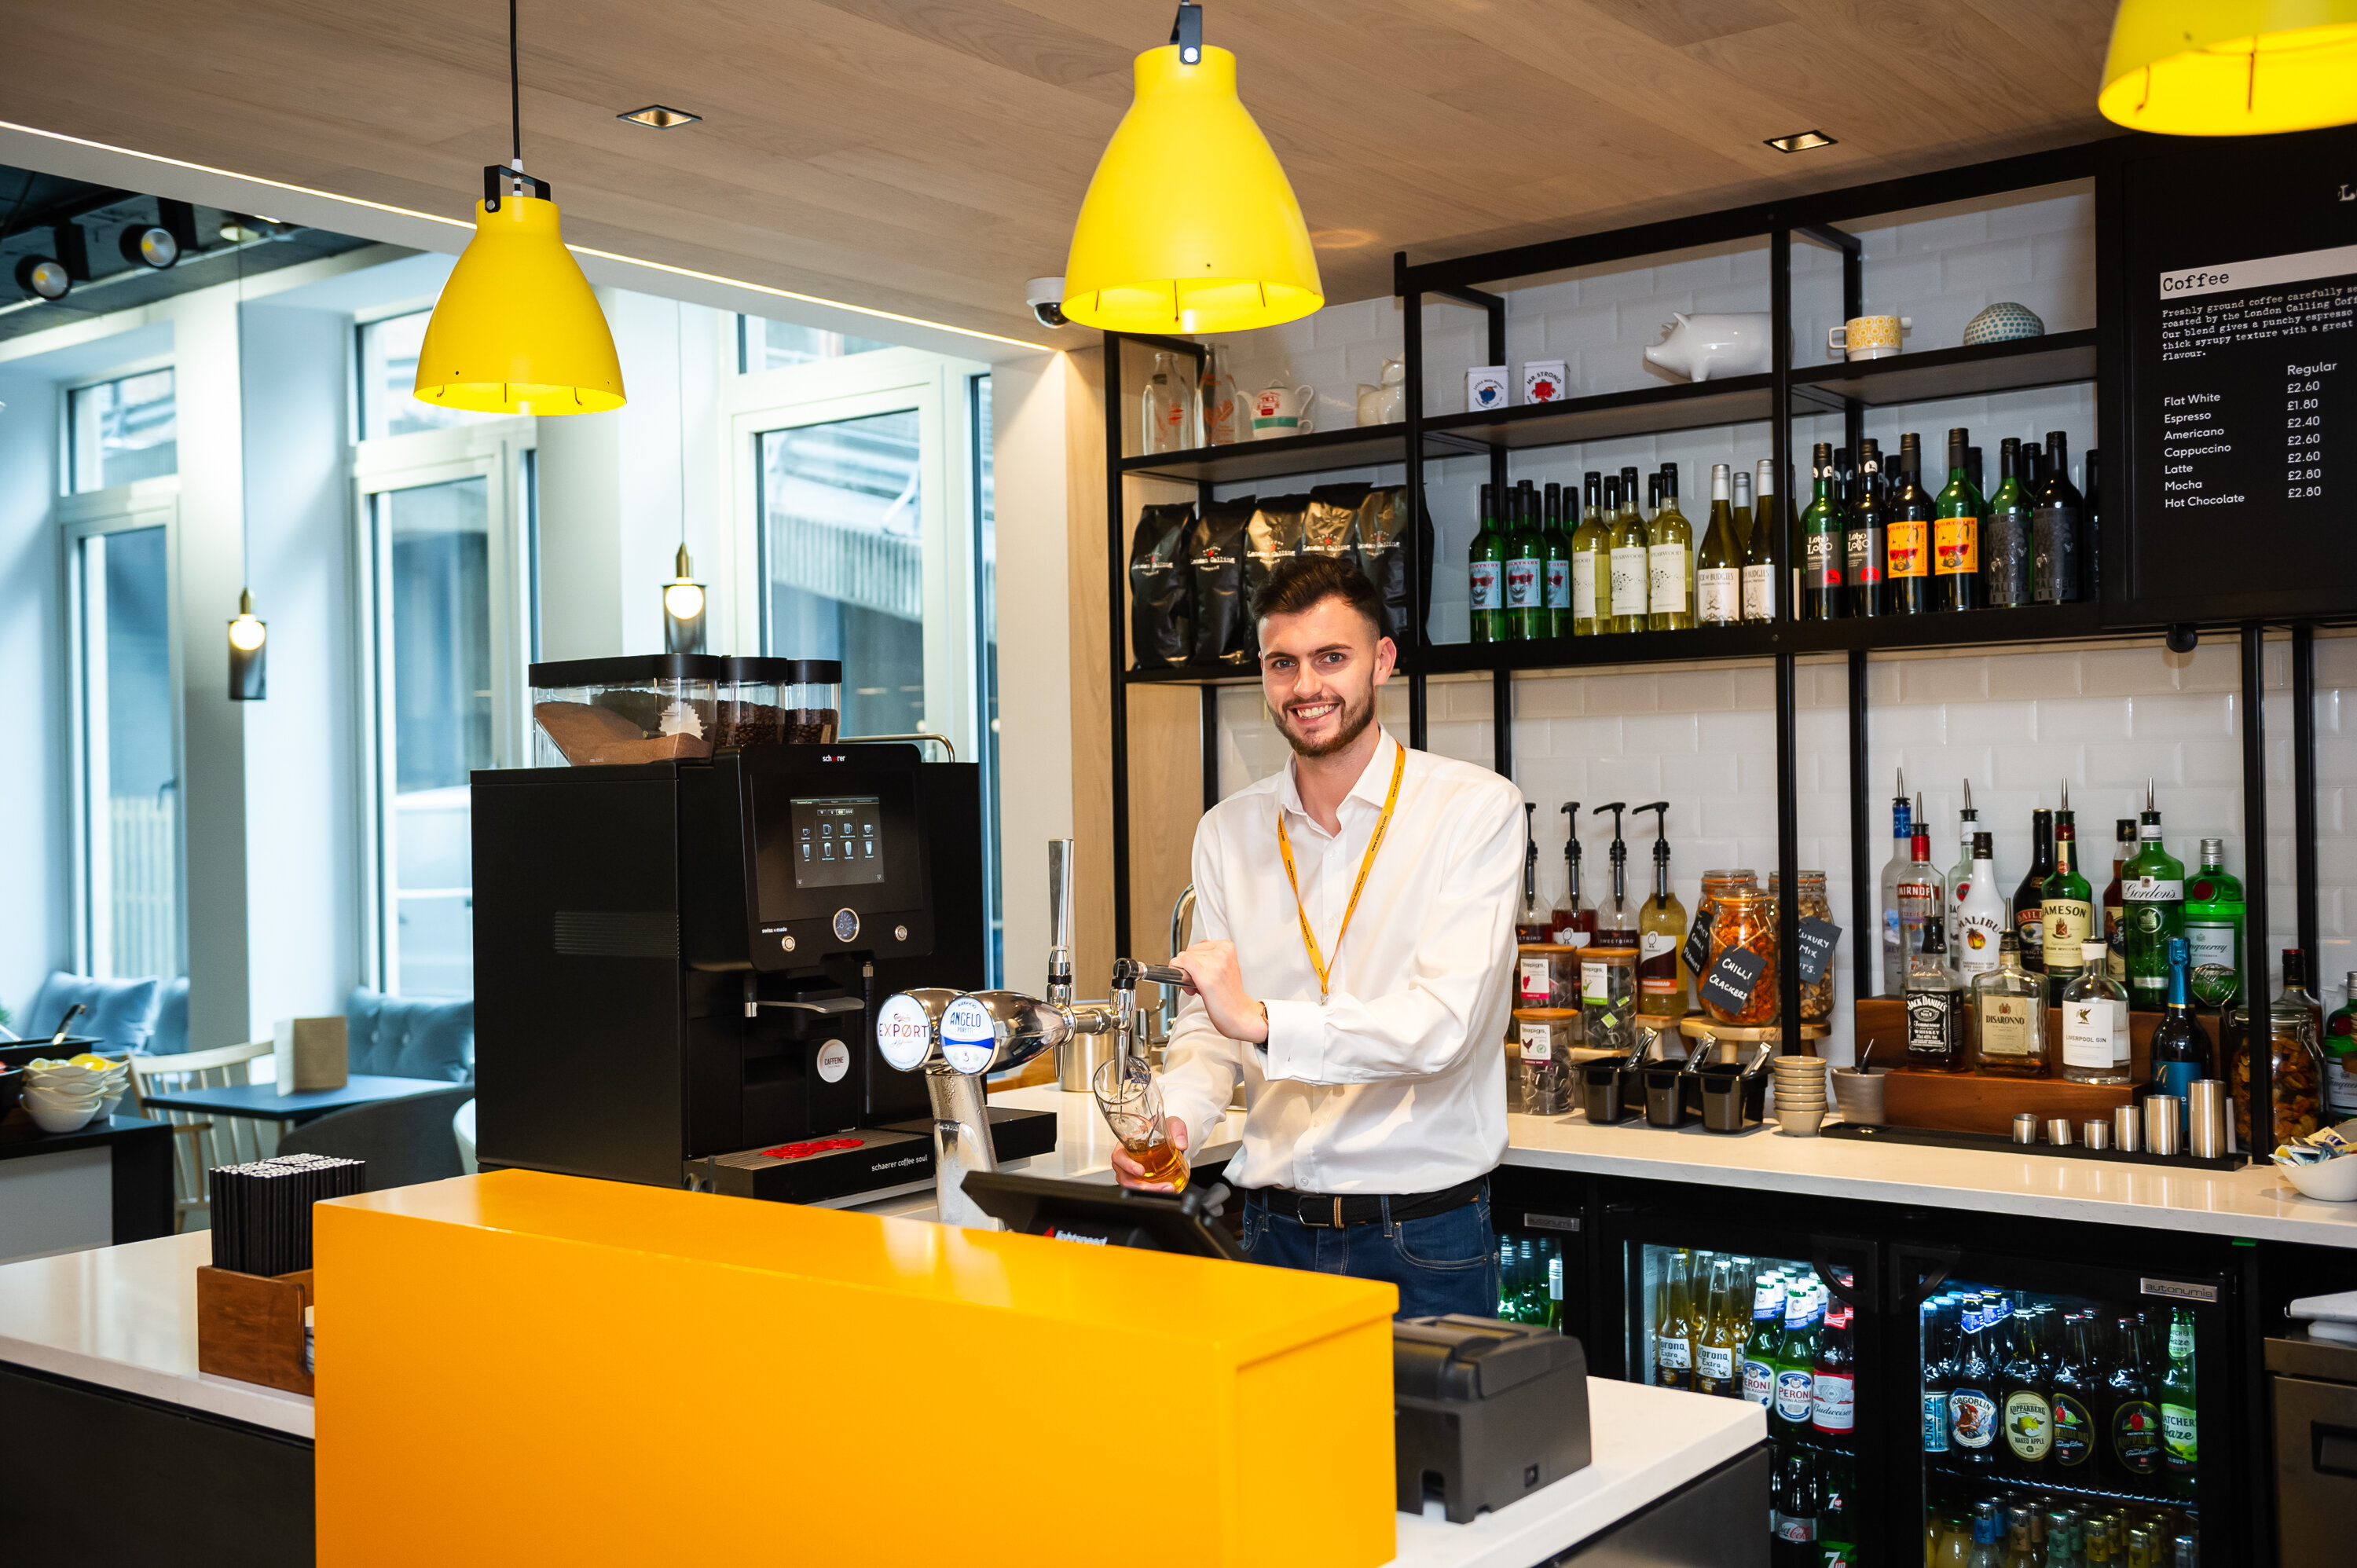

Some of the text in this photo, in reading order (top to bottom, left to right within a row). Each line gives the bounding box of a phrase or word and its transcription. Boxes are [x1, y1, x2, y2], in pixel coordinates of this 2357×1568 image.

[2162, 273, 2230, 291] Coffee
[2162, 306, 2203, 317] Freshly
[2207, 299, 2245, 313] ground
[2249, 295, 2283, 306] coffee
[2287, 288, 2343, 301] carefully
[2162, 316, 2201, 328] roasted
[2205, 315, 2218, 324] by
[2244, 307, 2282, 318] London
[2286, 301, 2330, 313] Calling
[2162, 331, 2181, 339] Our
[2184, 325, 2215, 337] blend
[2220, 323, 2249, 334] gives
[2263, 315, 2302, 328] punchy
[2305, 309, 2353, 321] espresso
[2162, 339, 2191, 350] thick
[2195, 335, 2232, 347] syrupy
[2235, 330, 2278, 341] texture
[2282, 325, 2308, 335] with
[2322, 320, 2354, 332] great
[2162, 350, 2206, 361] flavour.
[2287, 361, 2338, 376] Regular
[1537, 371, 1562, 384] STRONG
[2164, 380, 2320, 407] Flat White £2.60
[2164, 398, 2319, 425] Espresso £1.80
[2164, 416, 2320, 441] Americano £2.40
[2164, 434, 2320, 459] Cappuccino £2.60
[2165, 451, 2321, 474] Latte £2.60
[2165, 468, 2322, 491] Mocha £2.80
[2165, 485, 2322, 508] Hot Chocolate £2.80
[1371, 815, 1388, 852] www.staycity.com
[1898, 886, 1930, 896] MIRNOF
[2124, 881, 2177, 899] Gordon's
[1958, 915, 2001, 933] MALIBU
[1684, 946, 1700, 973] PEANUTS
[1708, 973, 1748, 1000] CRACKERS
[1907, 995, 1948, 1012] JACK DANIEL'S
[949, 1011, 981, 1028] ANGELO
[1985, 1015, 2025, 1025] DISARONNO
[824, 1056, 844, 1065] CAFFEINE
[962, 1052, 970, 1062] 3
[871, 1154, 929, 1171] schaerer coffee soul
[2145, 1284, 2213, 1298] autonumis
[1660, 1349, 1678, 1358] Extra
[1697, 1346, 1728, 1361] Corona
[1702, 1357, 1721, 1368] Extra
[1778, 1386, 1812, 1398] PERONI
[1813, 1403, 1853, 1416] Budweiser
[1951, 1397, 1991, 1411] HOBGOBLIN
[2009, 1405, 2046, 1416] KOPPARBERG
[2163, 1415, 2196, 1427] ATCHER
[1925, 1418, 1934, 1449] PUNK
